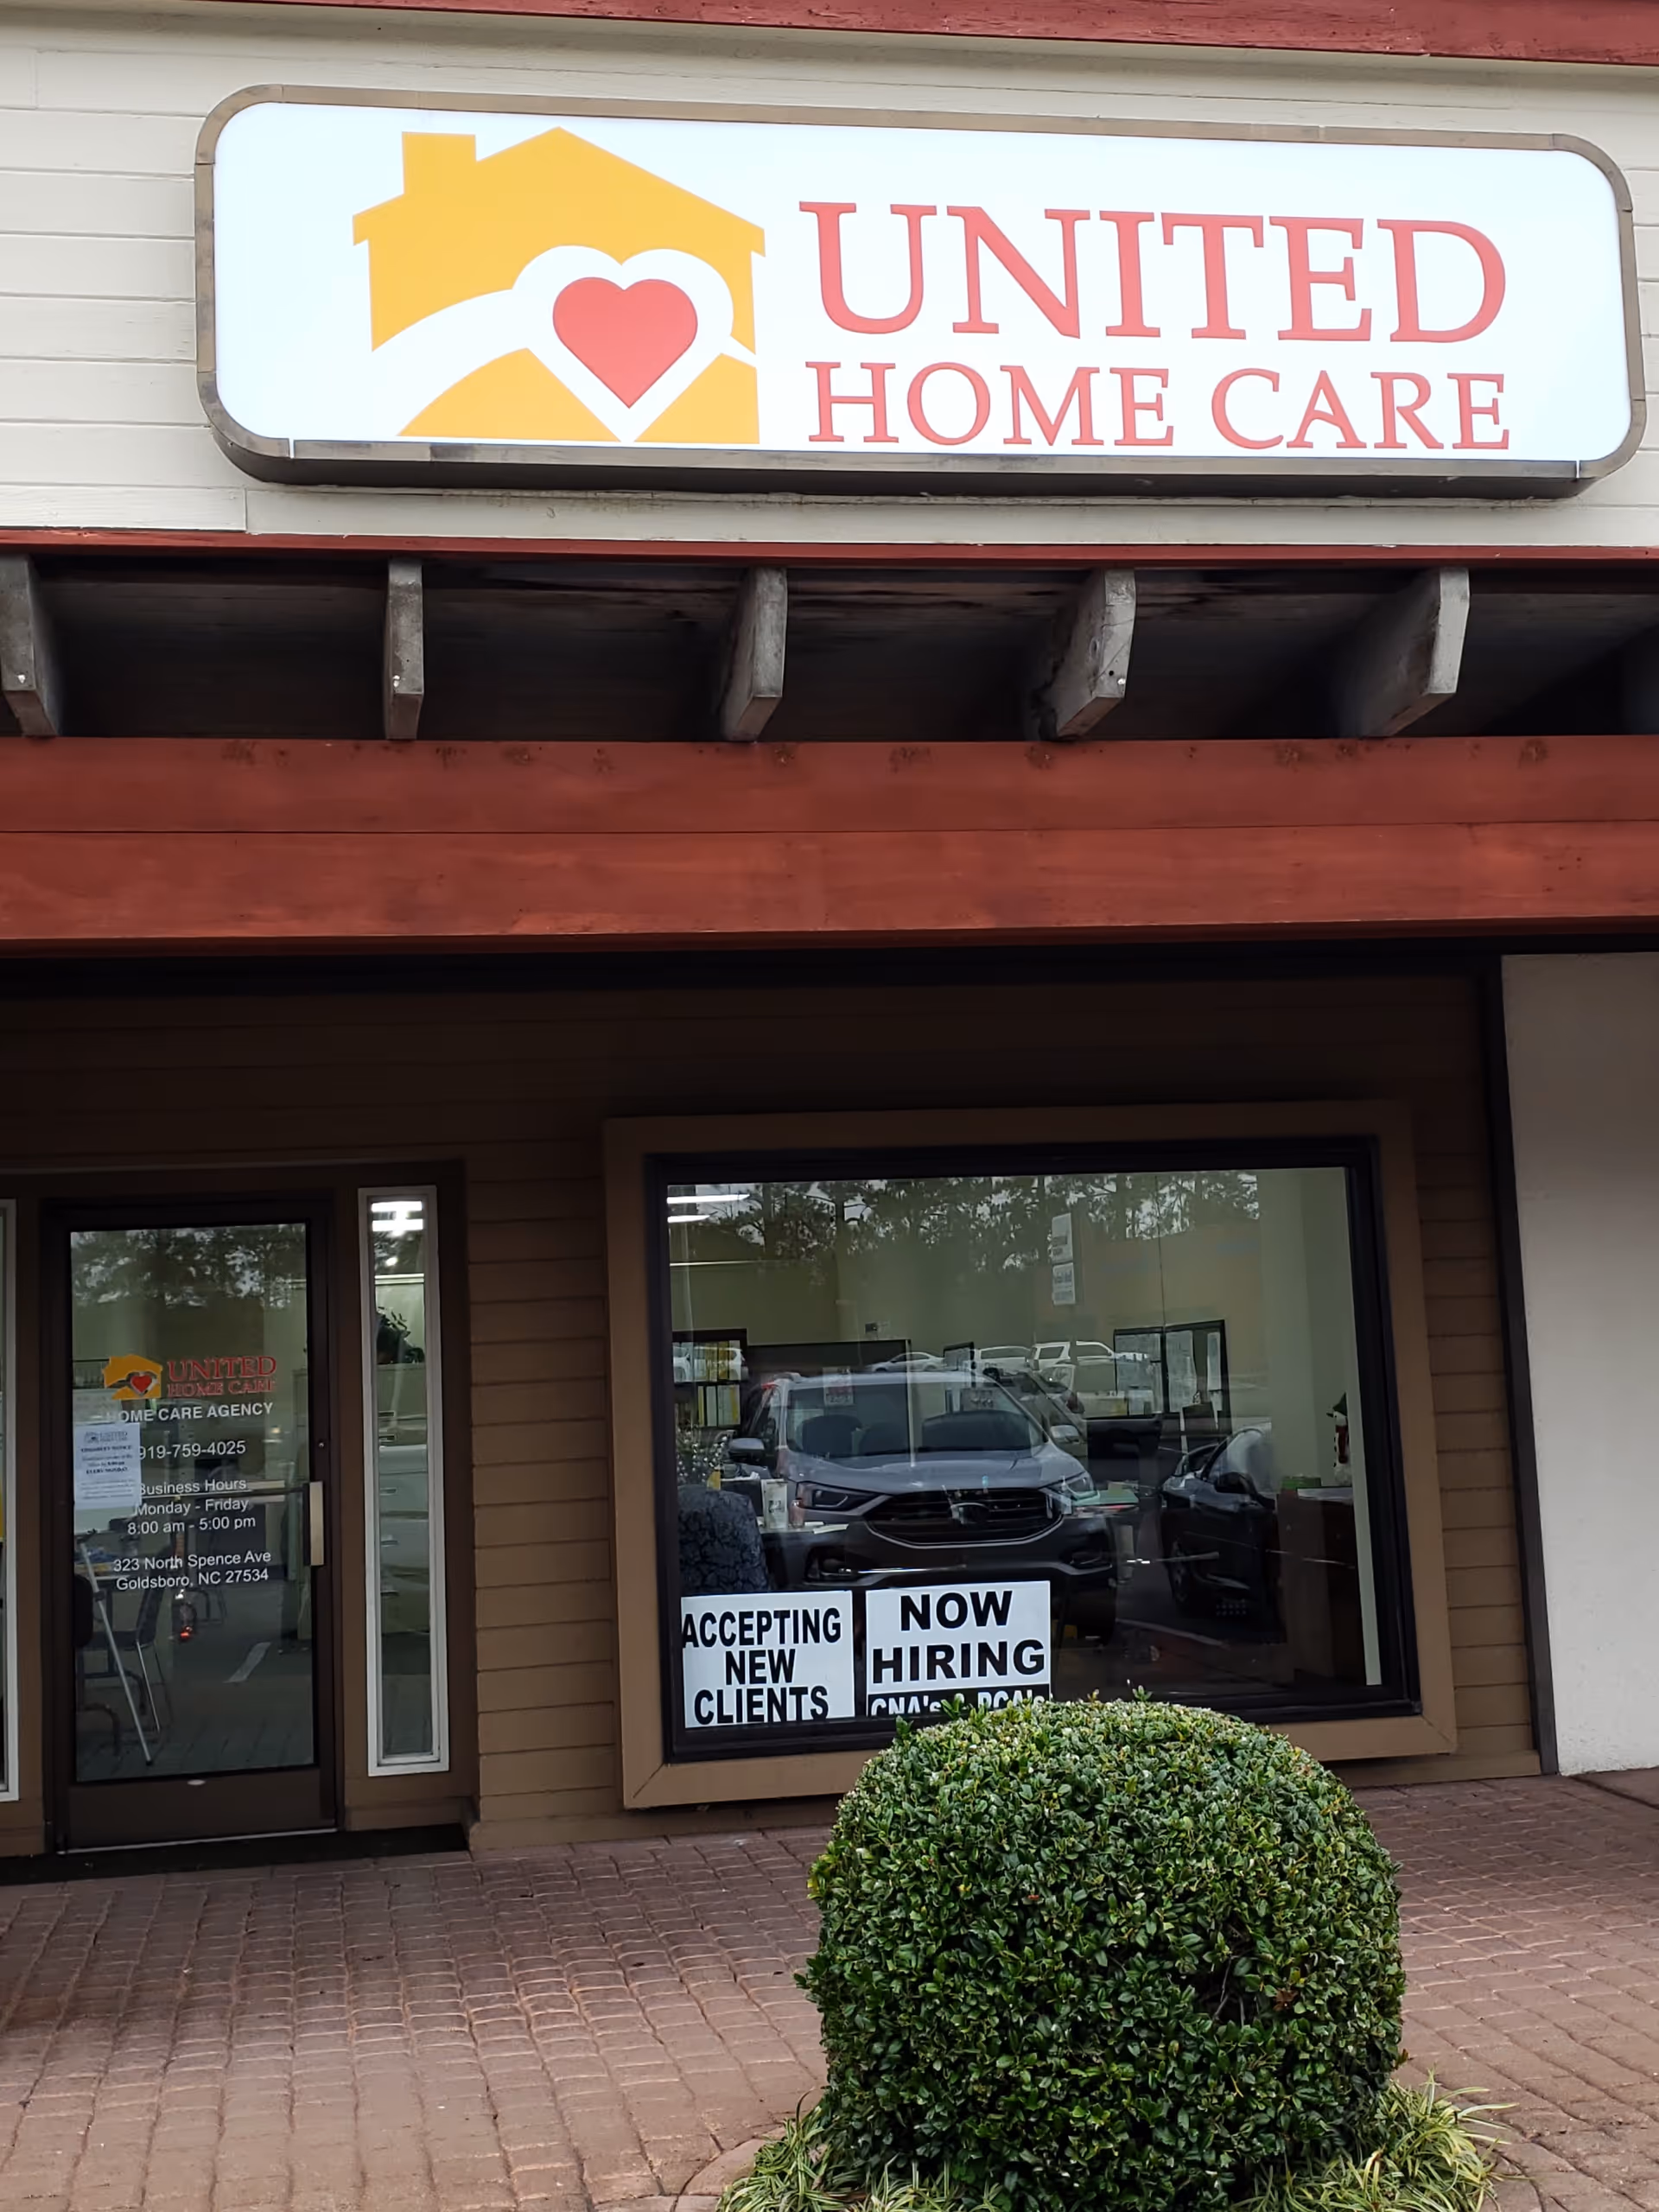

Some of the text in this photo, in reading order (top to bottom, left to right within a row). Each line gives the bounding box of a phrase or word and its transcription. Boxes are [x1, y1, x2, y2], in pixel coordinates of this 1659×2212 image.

[799, 201, 1507, 343] UNITED
[805, 361, 1510, 451] HOME CARE
[167, 1356, 277, 1382] UNITED
[167, 1380, 276, 1398] HOME CARE
[158, 1406, 203, 1421] CARE
[207, 1402, 274, 1419] AGENCY
[139, 1440, 246, 1460] 919-759-4025
[205, 1478, 247, 1492] Hours
[134, 1501, 191, 1516] Monday
[205, 1497, 249, 1512] Friday
[127, 1521, 159, 1535] 8:00
[162, 1522, 185, 1533] am
[199, 1516, 230, 1531] 5:00
[234, 1517, 256, 1530] pm
[113, 1550, 271, 1572] 323 North Spence Ave
[116, 1567, 269, 1591] Goldsboro, NC 27534
[899, 1590, 1013, 1631] NOW
[682, 1607, 842, 1649] ACCEPTING
[725, 1648, 796, 1686] NEW
[872, 1638, 1045, 1684] HIRING
[694, 1685, 829, 1726] CLIENTS
